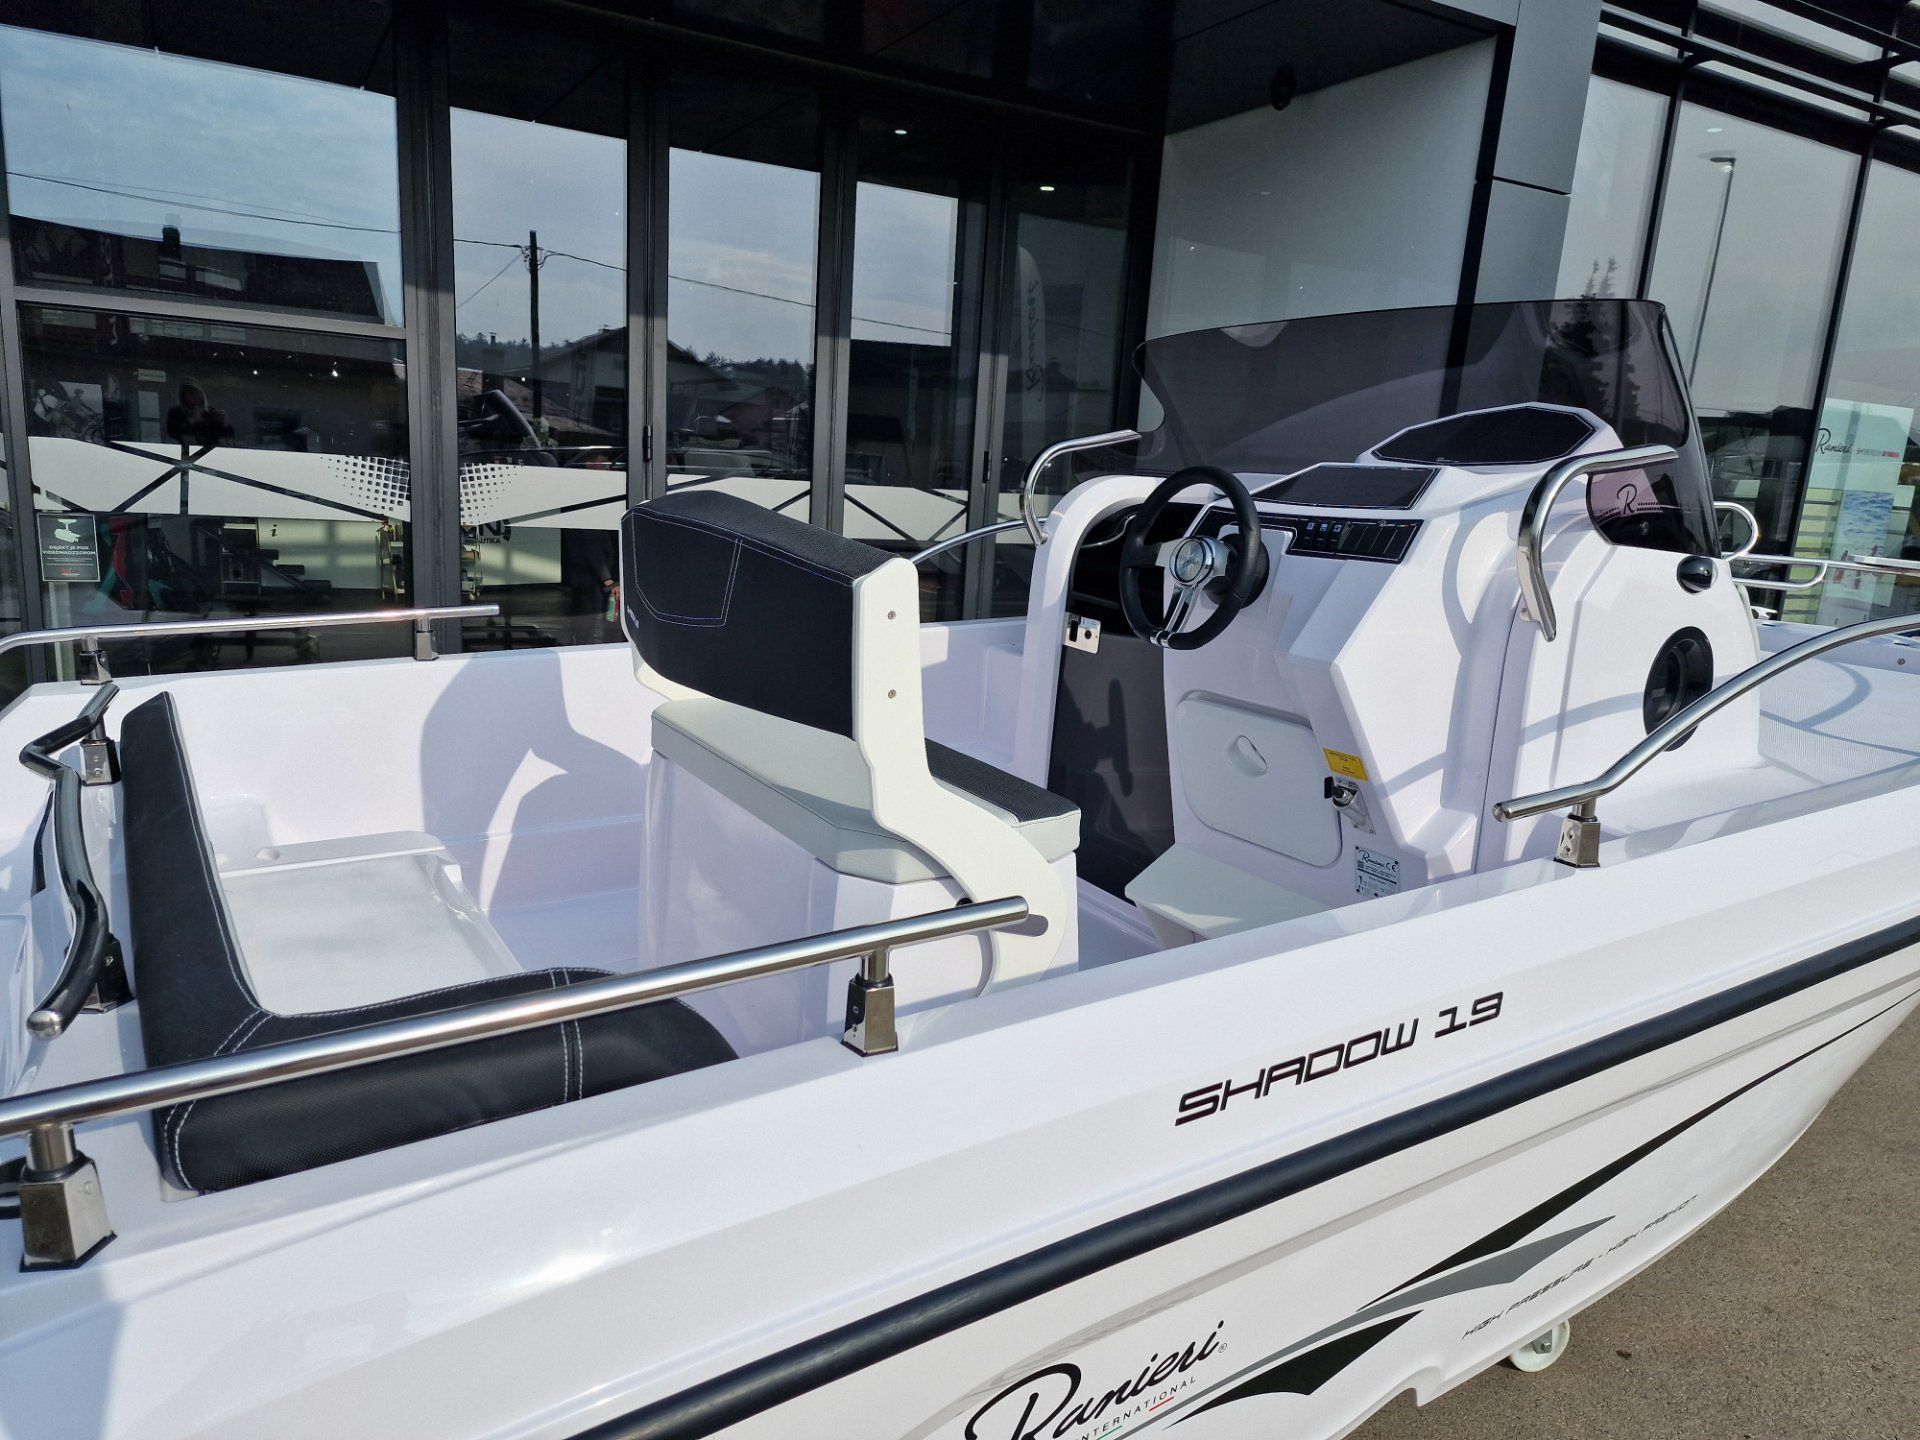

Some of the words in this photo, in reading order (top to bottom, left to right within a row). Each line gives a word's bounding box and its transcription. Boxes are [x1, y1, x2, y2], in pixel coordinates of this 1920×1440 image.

[1175, 1018, 1419, 1126] SHADOW
[1434, 991, 1503, 1038] 19
[1462, 1310, 1504, 1340] HIGH
[1506, 1257, 1595, 1315] PRESSURE
[964, 1320, 1225, 1440] Ranieri
[1075, 1376, 1196, 1440] NTERNATIONAL
